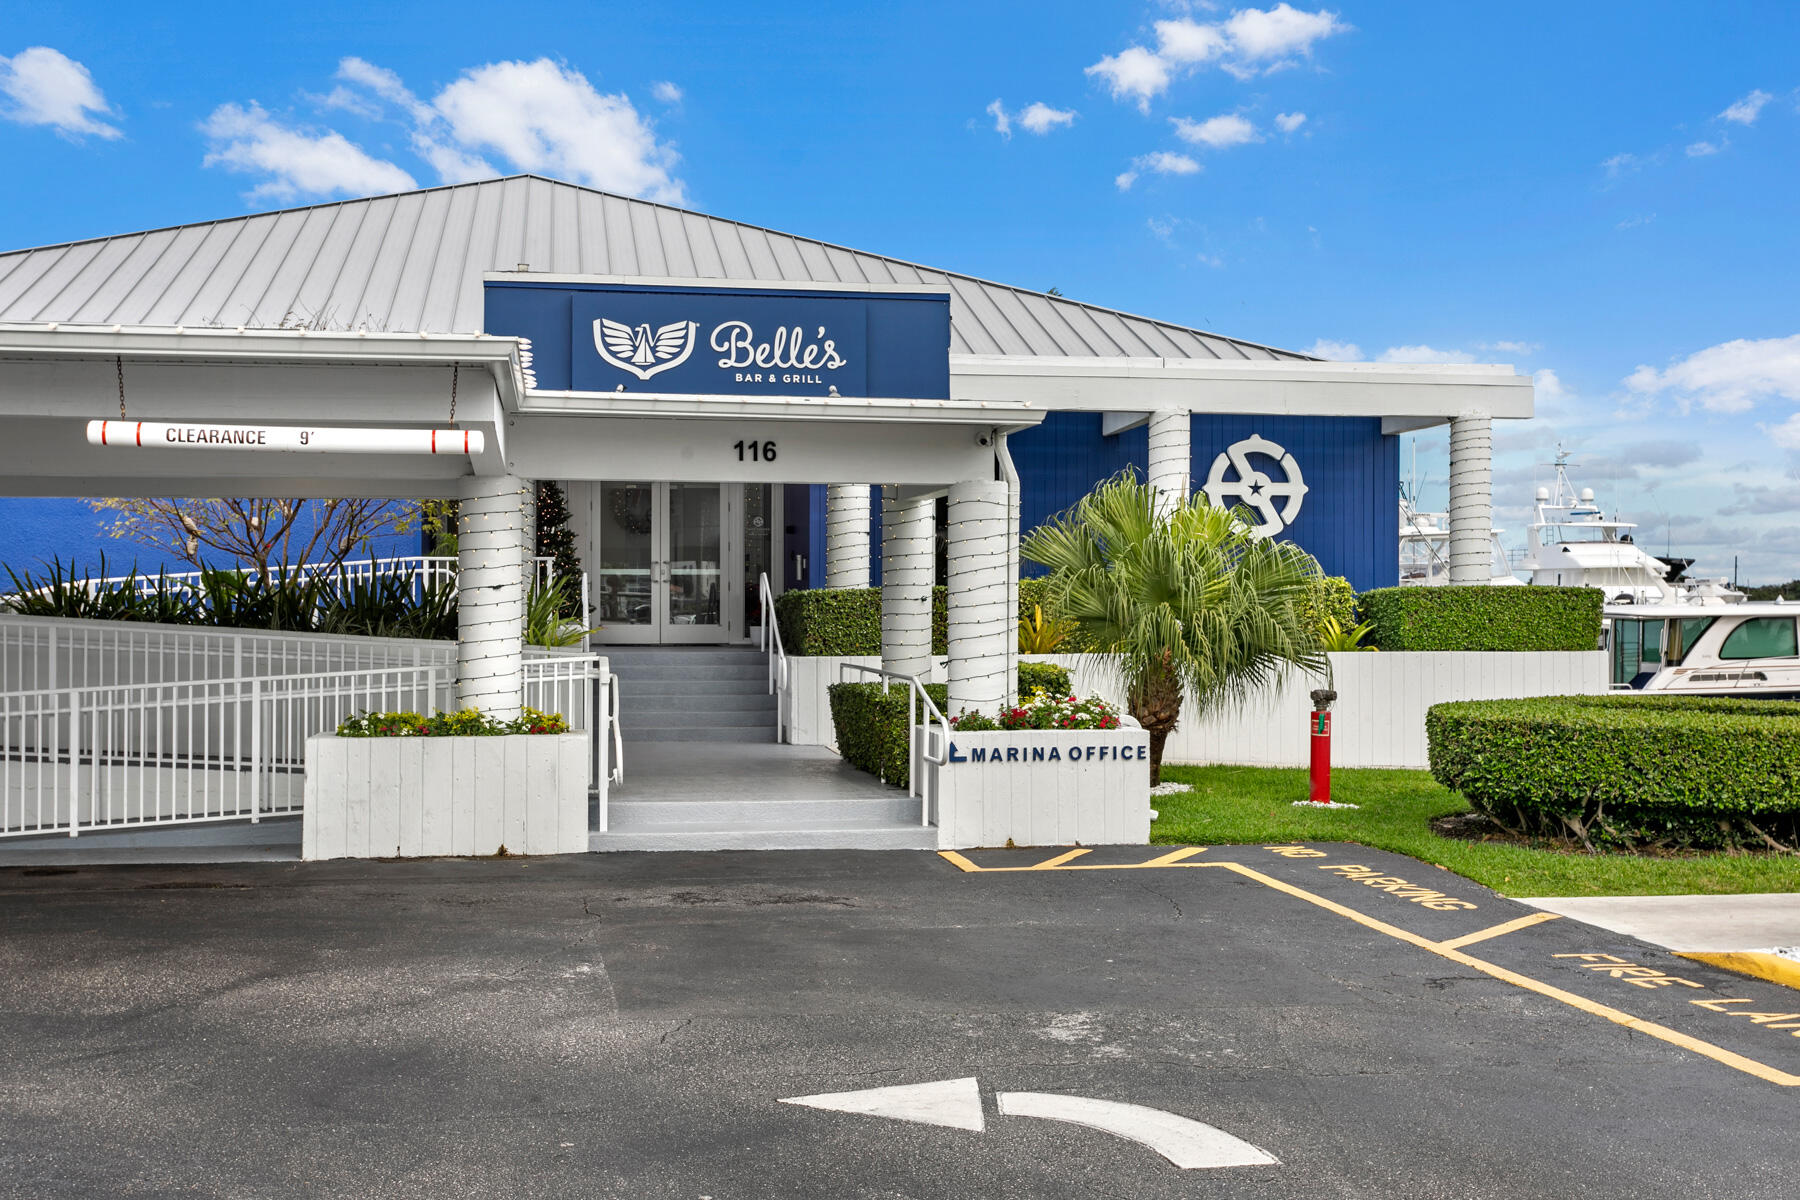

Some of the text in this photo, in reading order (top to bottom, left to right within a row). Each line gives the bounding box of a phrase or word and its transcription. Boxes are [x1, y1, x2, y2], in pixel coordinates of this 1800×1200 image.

[710, 321, 847, 369] Belle's
[735, 373, 823, 384] BAR & GRILL
[165, 428, 316, 445] CLEARANCE 9'
[733, 441, 777, 462] 116
[971, 745, 1147, 762] MARINA OFFICE
[1263, 845, 1478, 911] NO PARKING
[1552, 953, 1705, 989] FIRE
